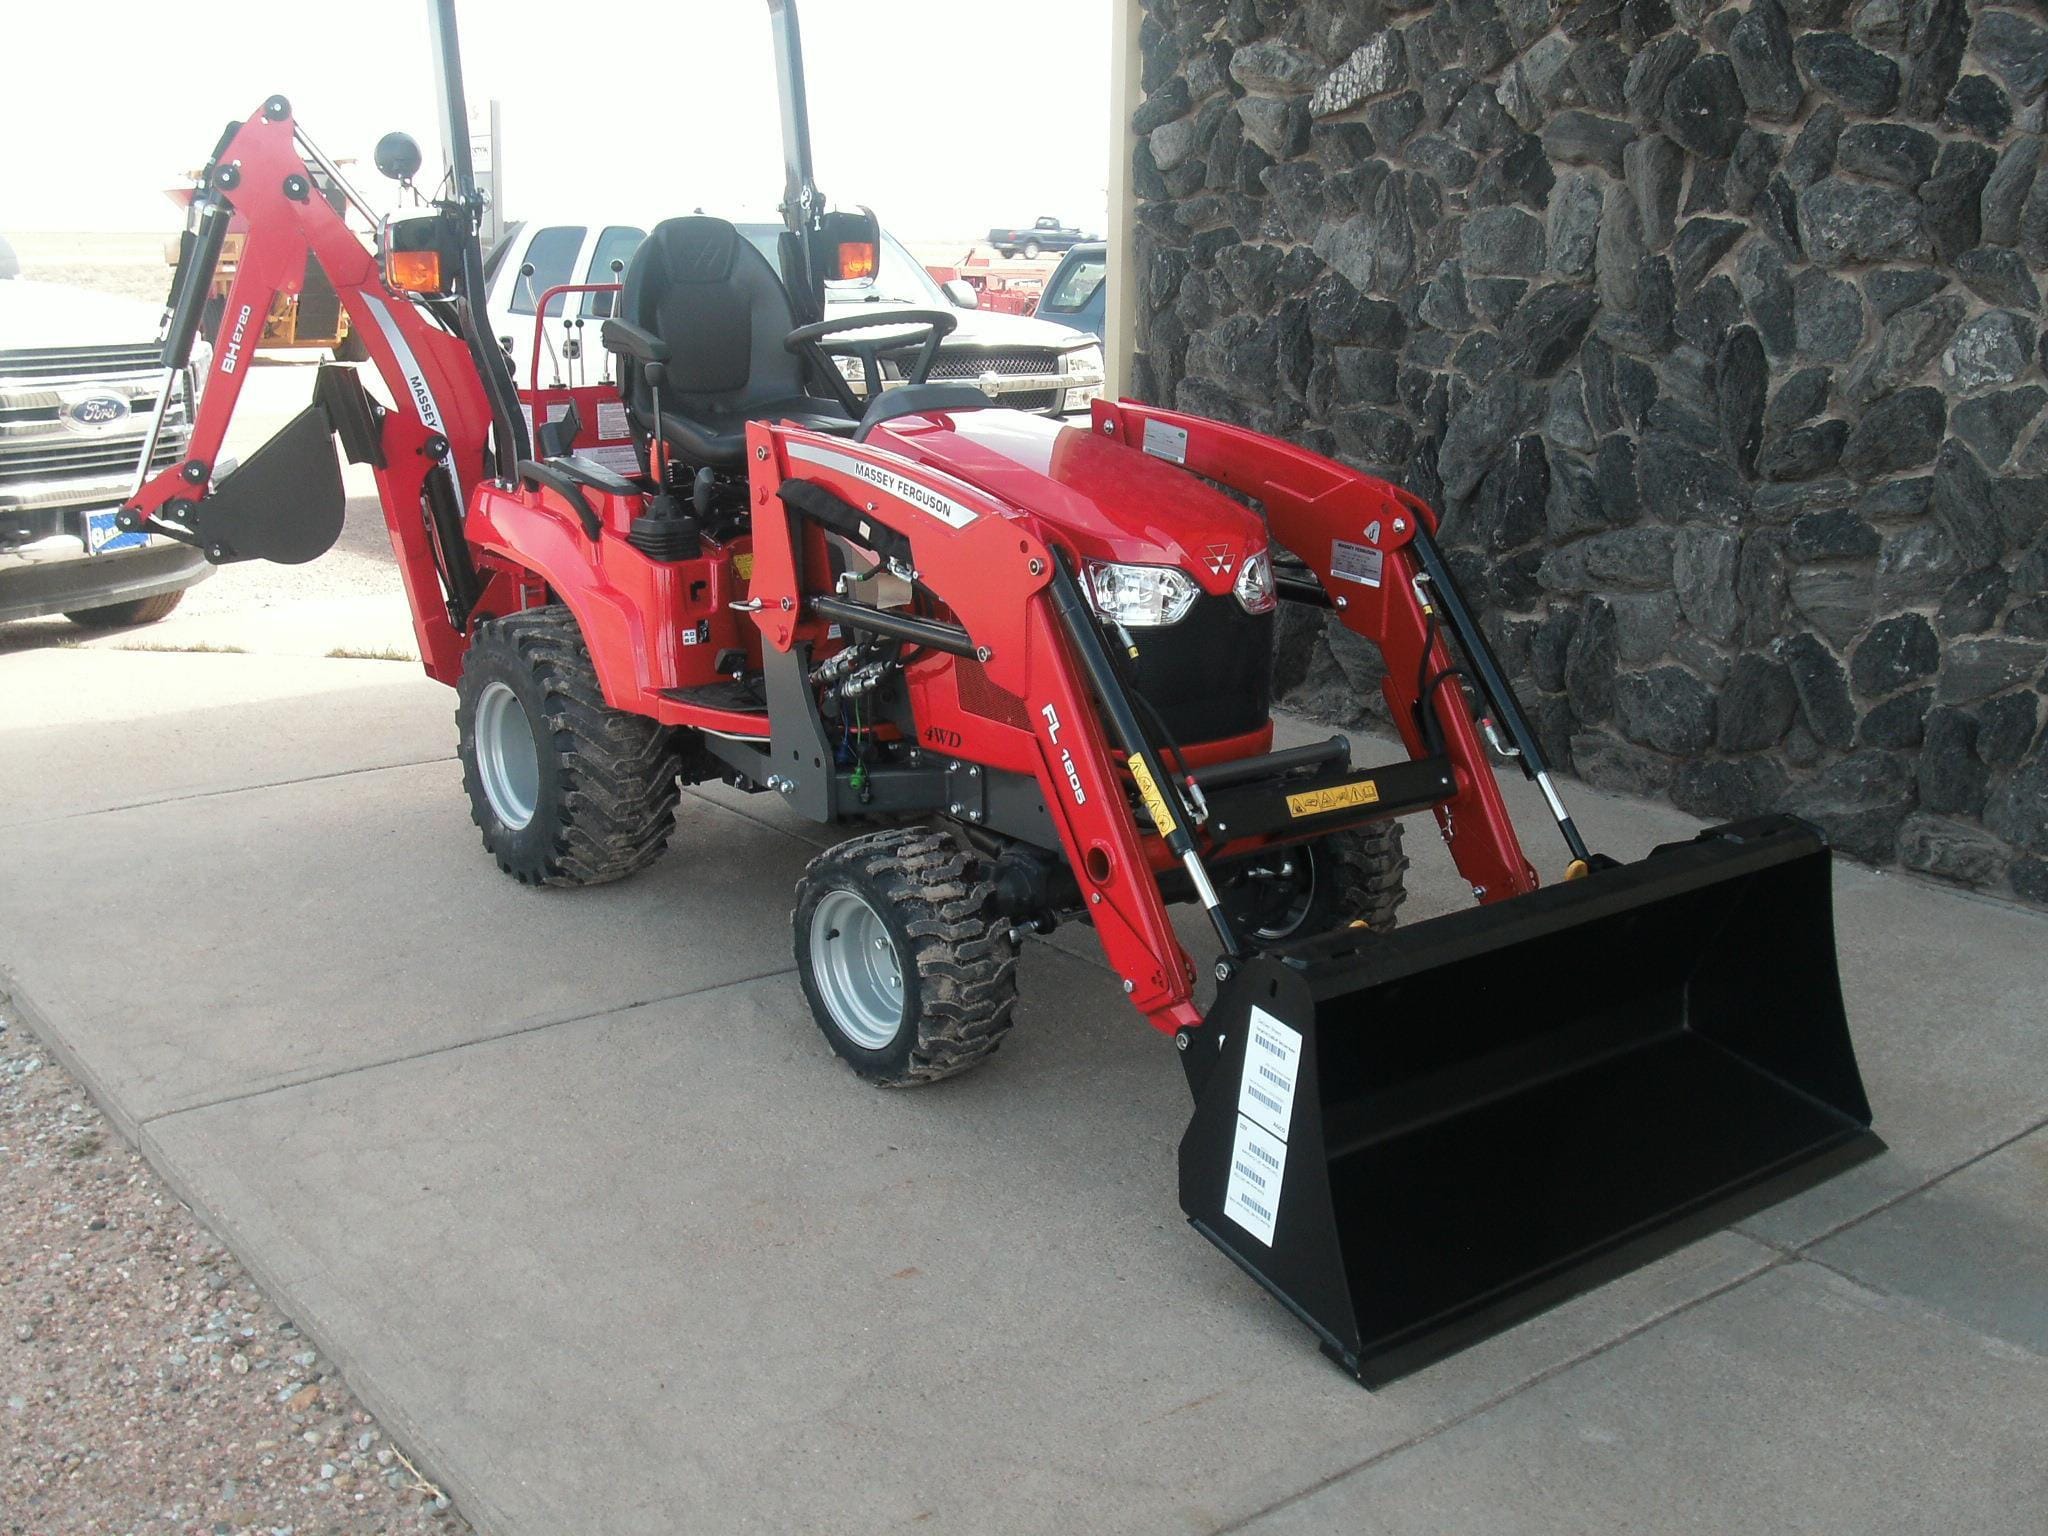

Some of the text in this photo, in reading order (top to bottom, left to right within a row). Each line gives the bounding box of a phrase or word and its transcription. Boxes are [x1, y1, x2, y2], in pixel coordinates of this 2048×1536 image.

[221, 304, 251, 374] BH 2720
[83, 400, 116, 421] Ford
[410, 376, 437, 427] MASSEY
[855, 462, 951, 517] MASSEY FERGUSON
[924, 726, 962, 748] 4WD
[1042, 703, 1087, 805] FL 1805
